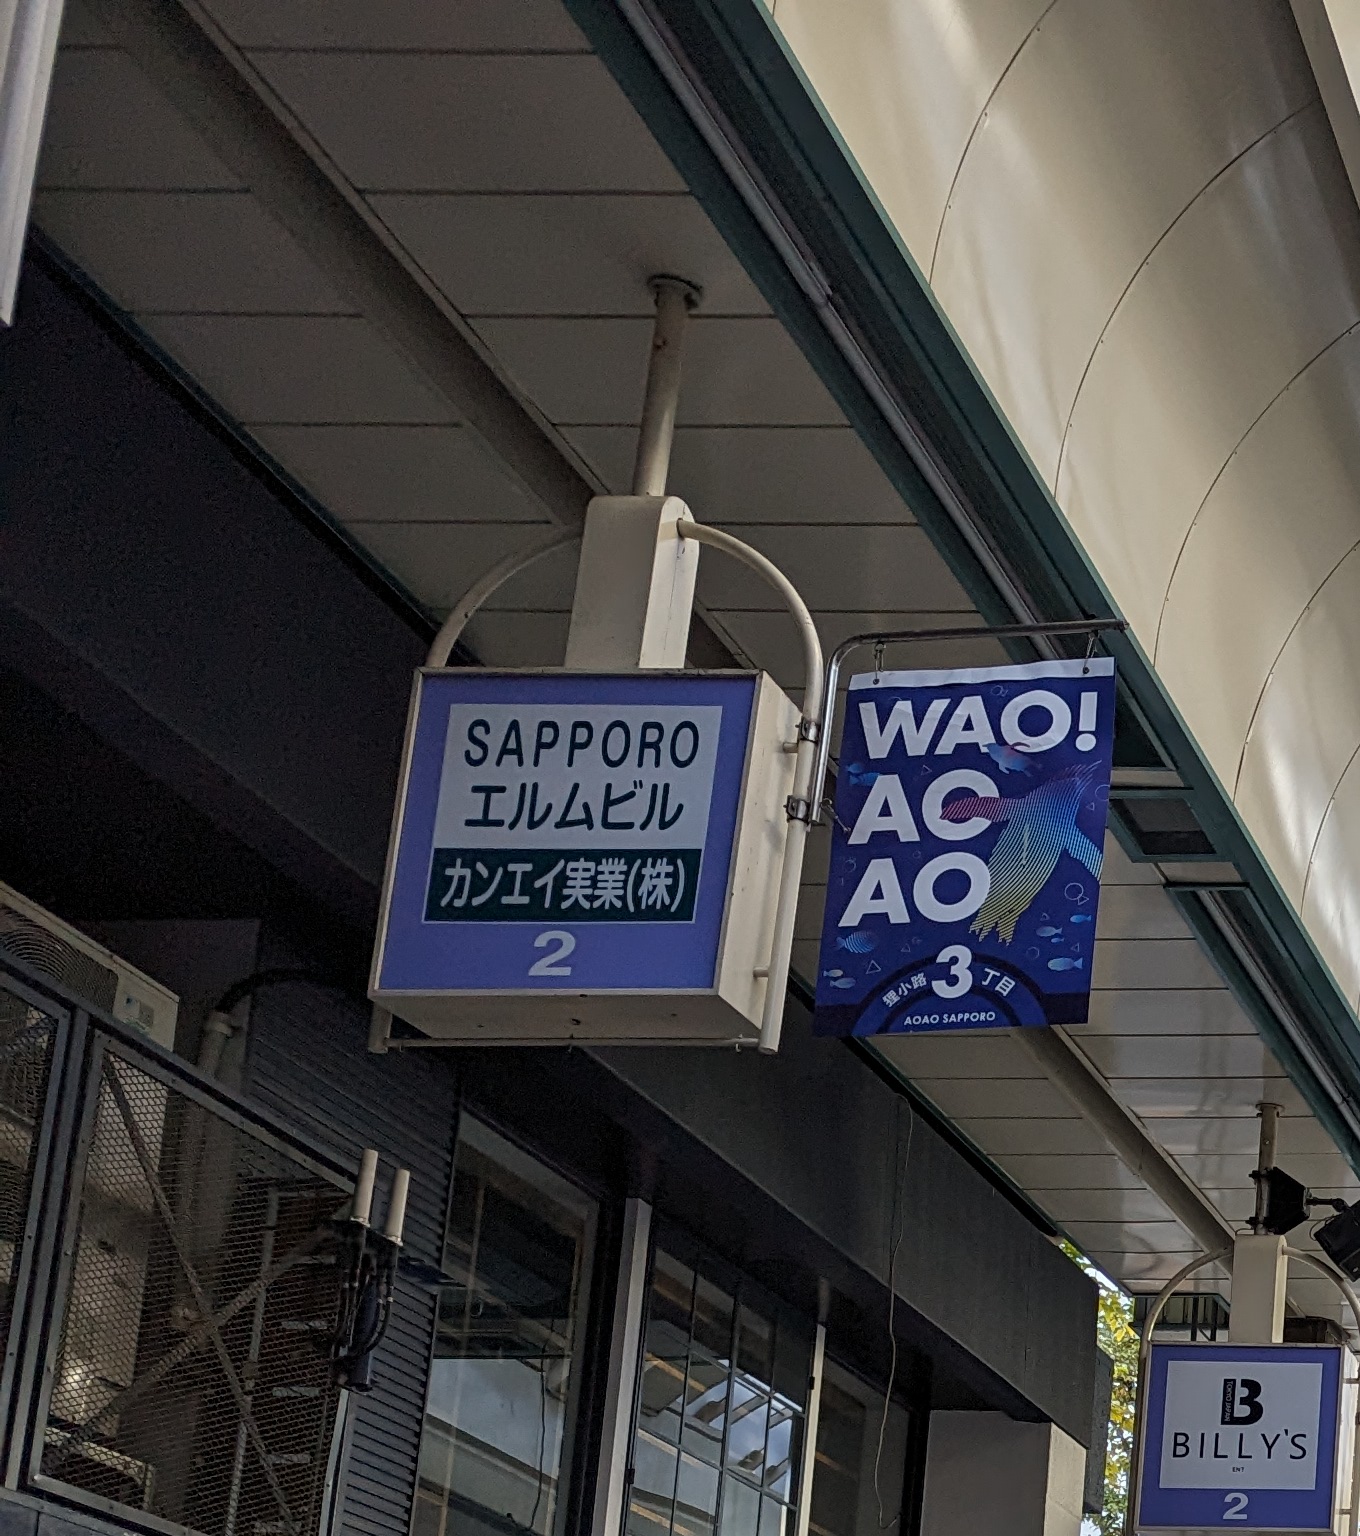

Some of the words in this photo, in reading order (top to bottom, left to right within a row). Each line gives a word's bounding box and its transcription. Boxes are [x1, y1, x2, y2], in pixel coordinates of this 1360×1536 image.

[464, 718, 700, 771] SAPPORO
[859, 690, 1097, 760] WAO!
[464, 779, 685, 832] エルムビル
[441, 857, 687, 912] カンエイ実業(株)
[839, 851, 991, 928] AO
[528, 930, 577, 977] 2
[882, 971, 929, 1008] 狸小路
[930, 945, 975, 998] 3
[981, 966, 1018, 998] 丁目
[903, 1012, 941, 1026] AOAO
[943, 1010, 996, 1025] SAPPORO
[1172, 1428, 1308, 1460] BILLY'S
[1222, 1492, 1249, 1521] 2
